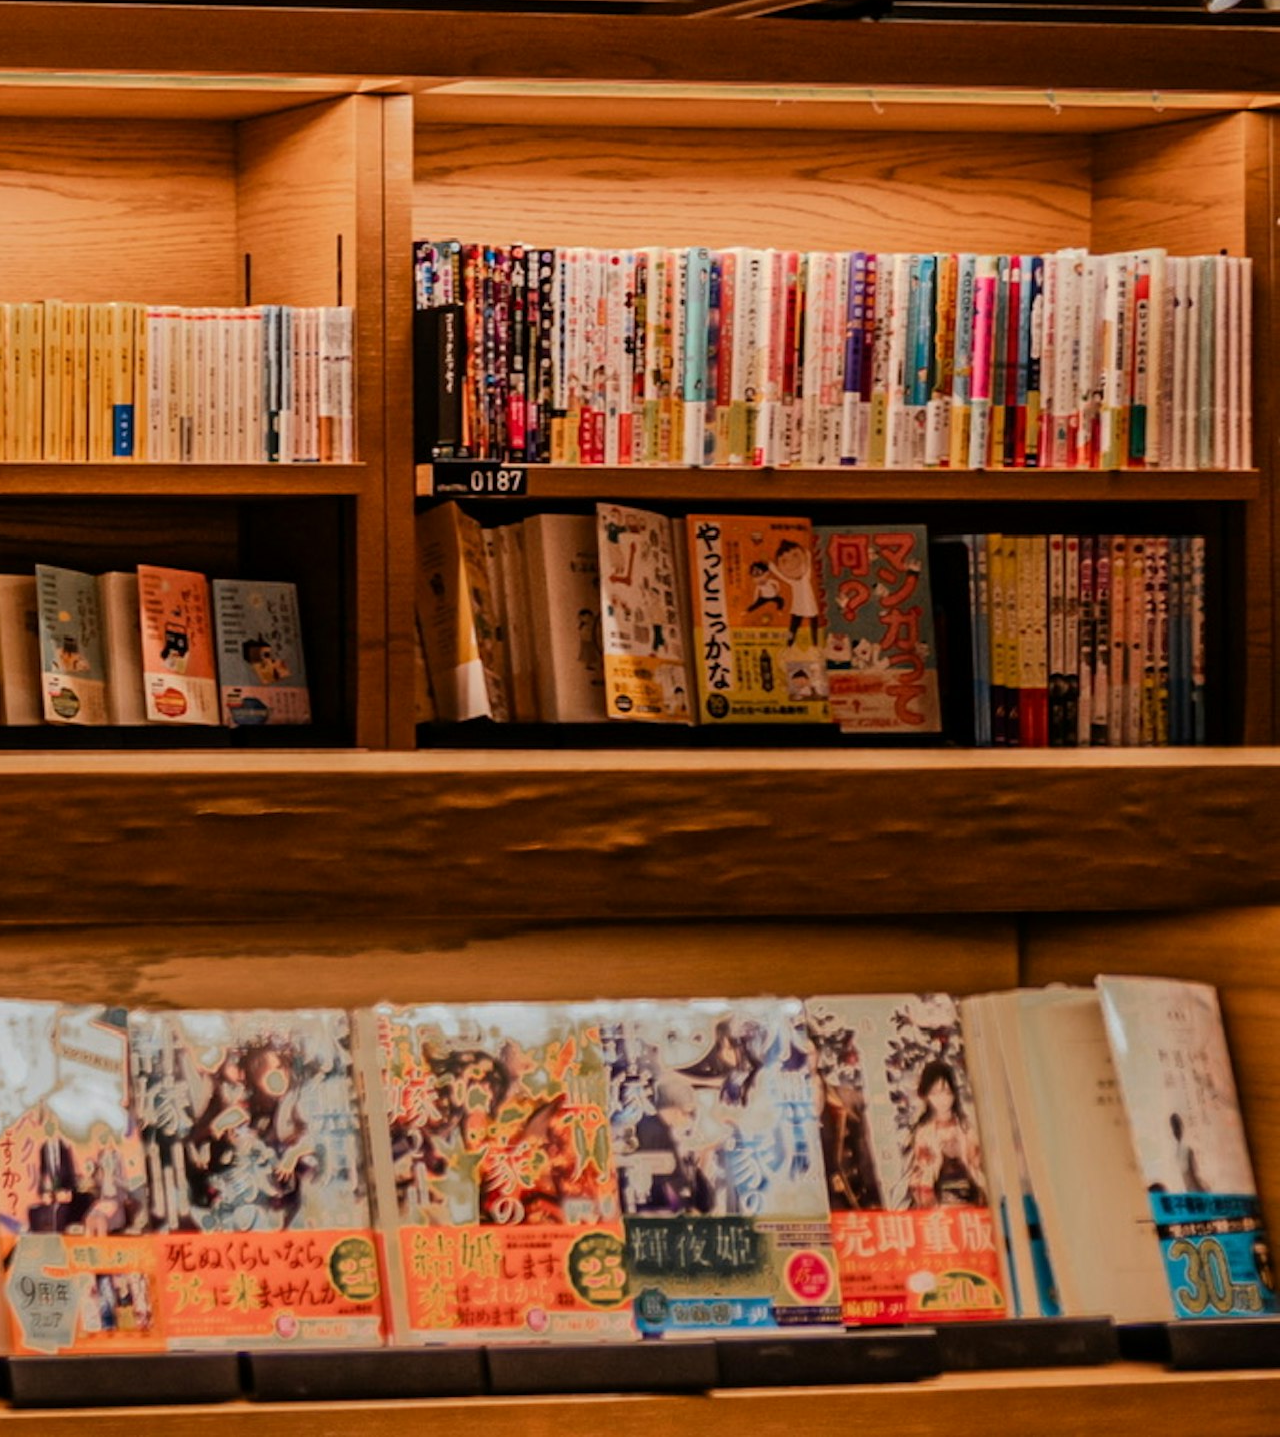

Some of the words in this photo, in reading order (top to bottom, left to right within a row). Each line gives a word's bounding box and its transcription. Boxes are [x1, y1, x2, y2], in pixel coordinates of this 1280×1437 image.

[470, 470, 523, 492] 0187
[827, 533, 871, 622] 何?
[873, 533, 926, 725] マンガって
[166, 1239, 324, 1271] 死ぬくらいなら
[631, 1223, 757, 1268] 輝夜姫
[835, 1211, 996, 1258] 売即重版
[168, 1274, 337, 1312] うちに来ませんか
